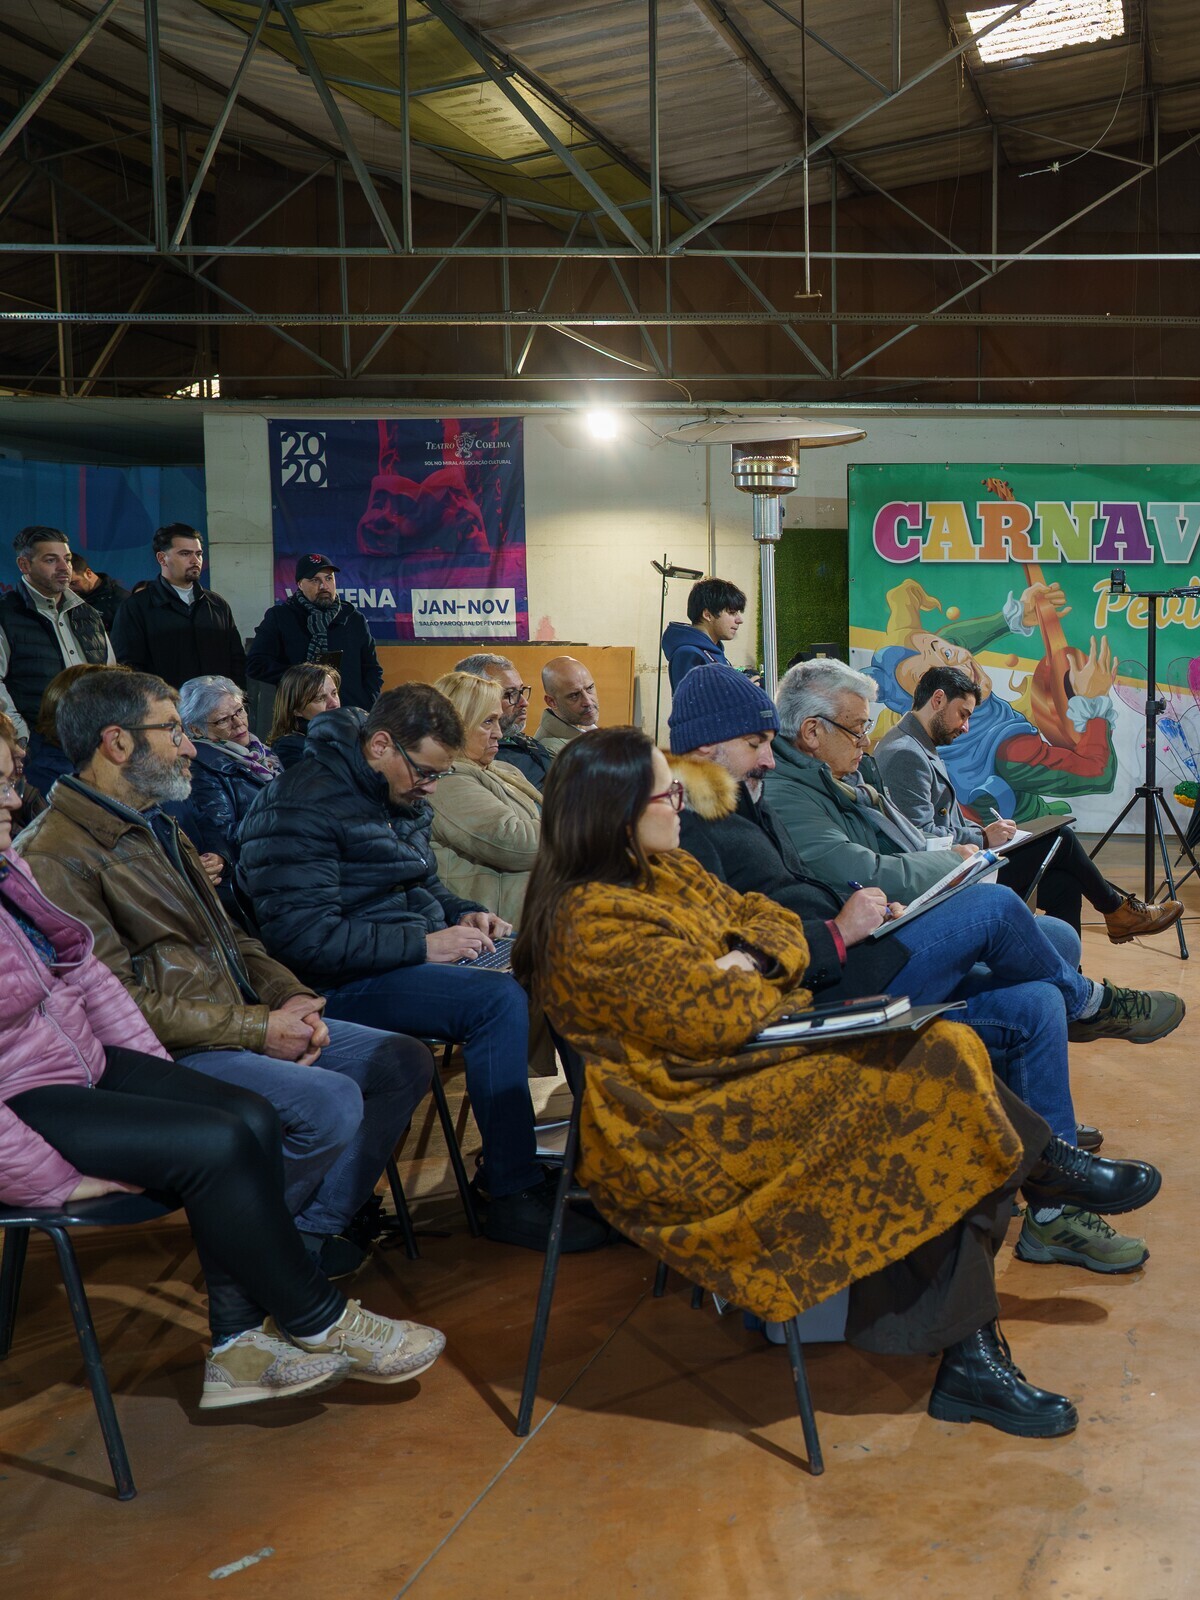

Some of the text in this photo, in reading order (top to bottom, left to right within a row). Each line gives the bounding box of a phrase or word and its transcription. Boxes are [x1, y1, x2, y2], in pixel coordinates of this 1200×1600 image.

[425, 440, 511, 450] TEATRO COELIMA
[418, 599, 510, 614] JAN-NOV
